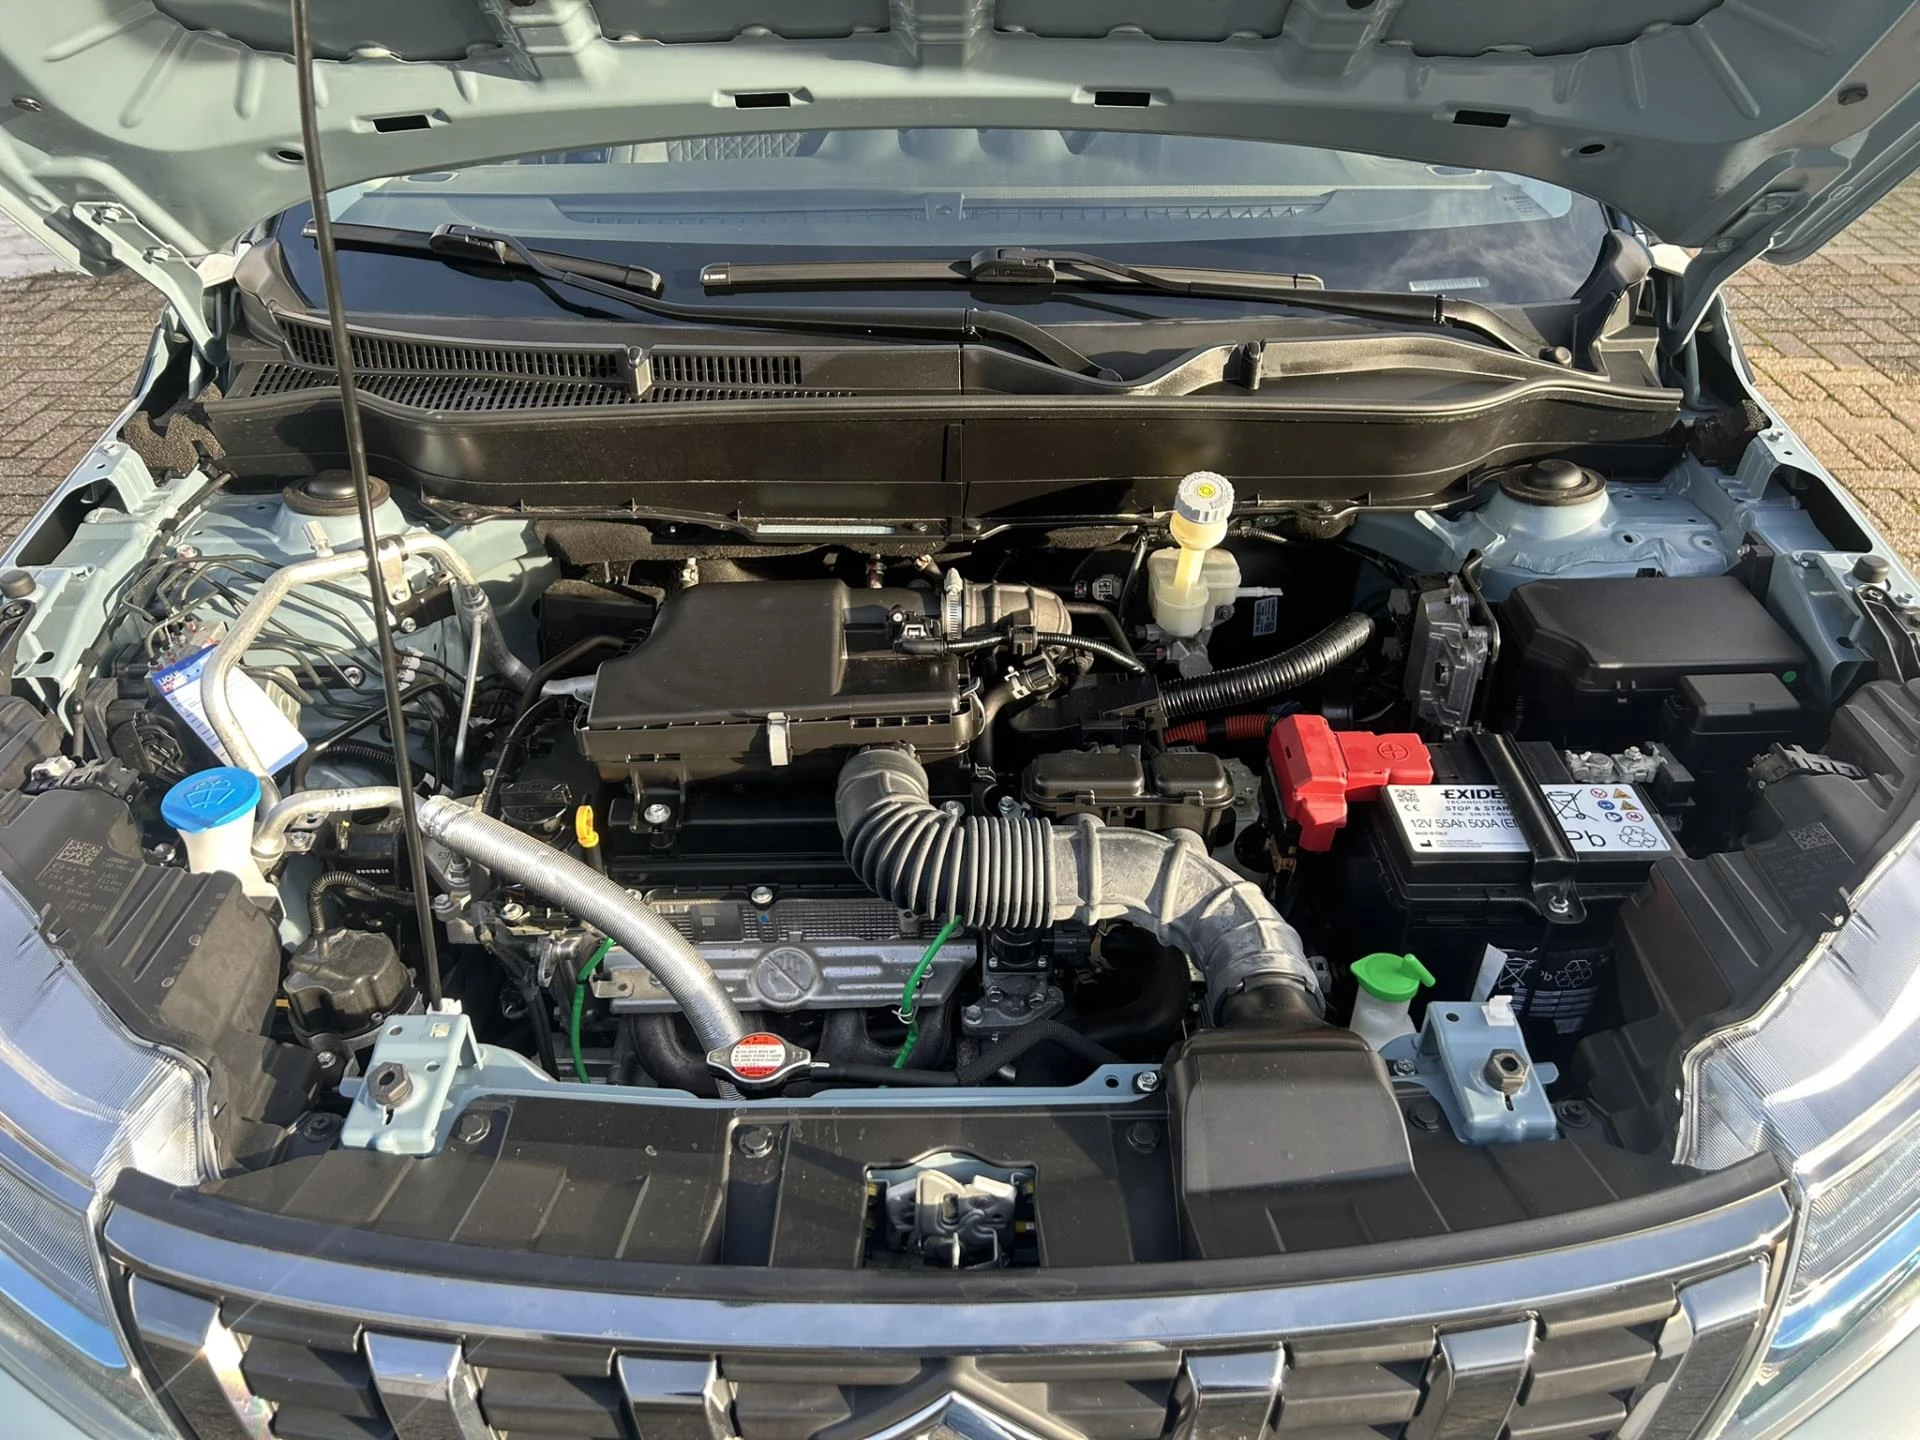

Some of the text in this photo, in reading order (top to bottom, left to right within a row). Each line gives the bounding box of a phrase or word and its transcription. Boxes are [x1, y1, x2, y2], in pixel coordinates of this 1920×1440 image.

[1441, 789, 1504, 799] EXIDE
[1411, 819, 1432, 828] 12V
[1435, 819, 1467, 828] 55Ah
[1468, 819, 1499, 828] 500A
